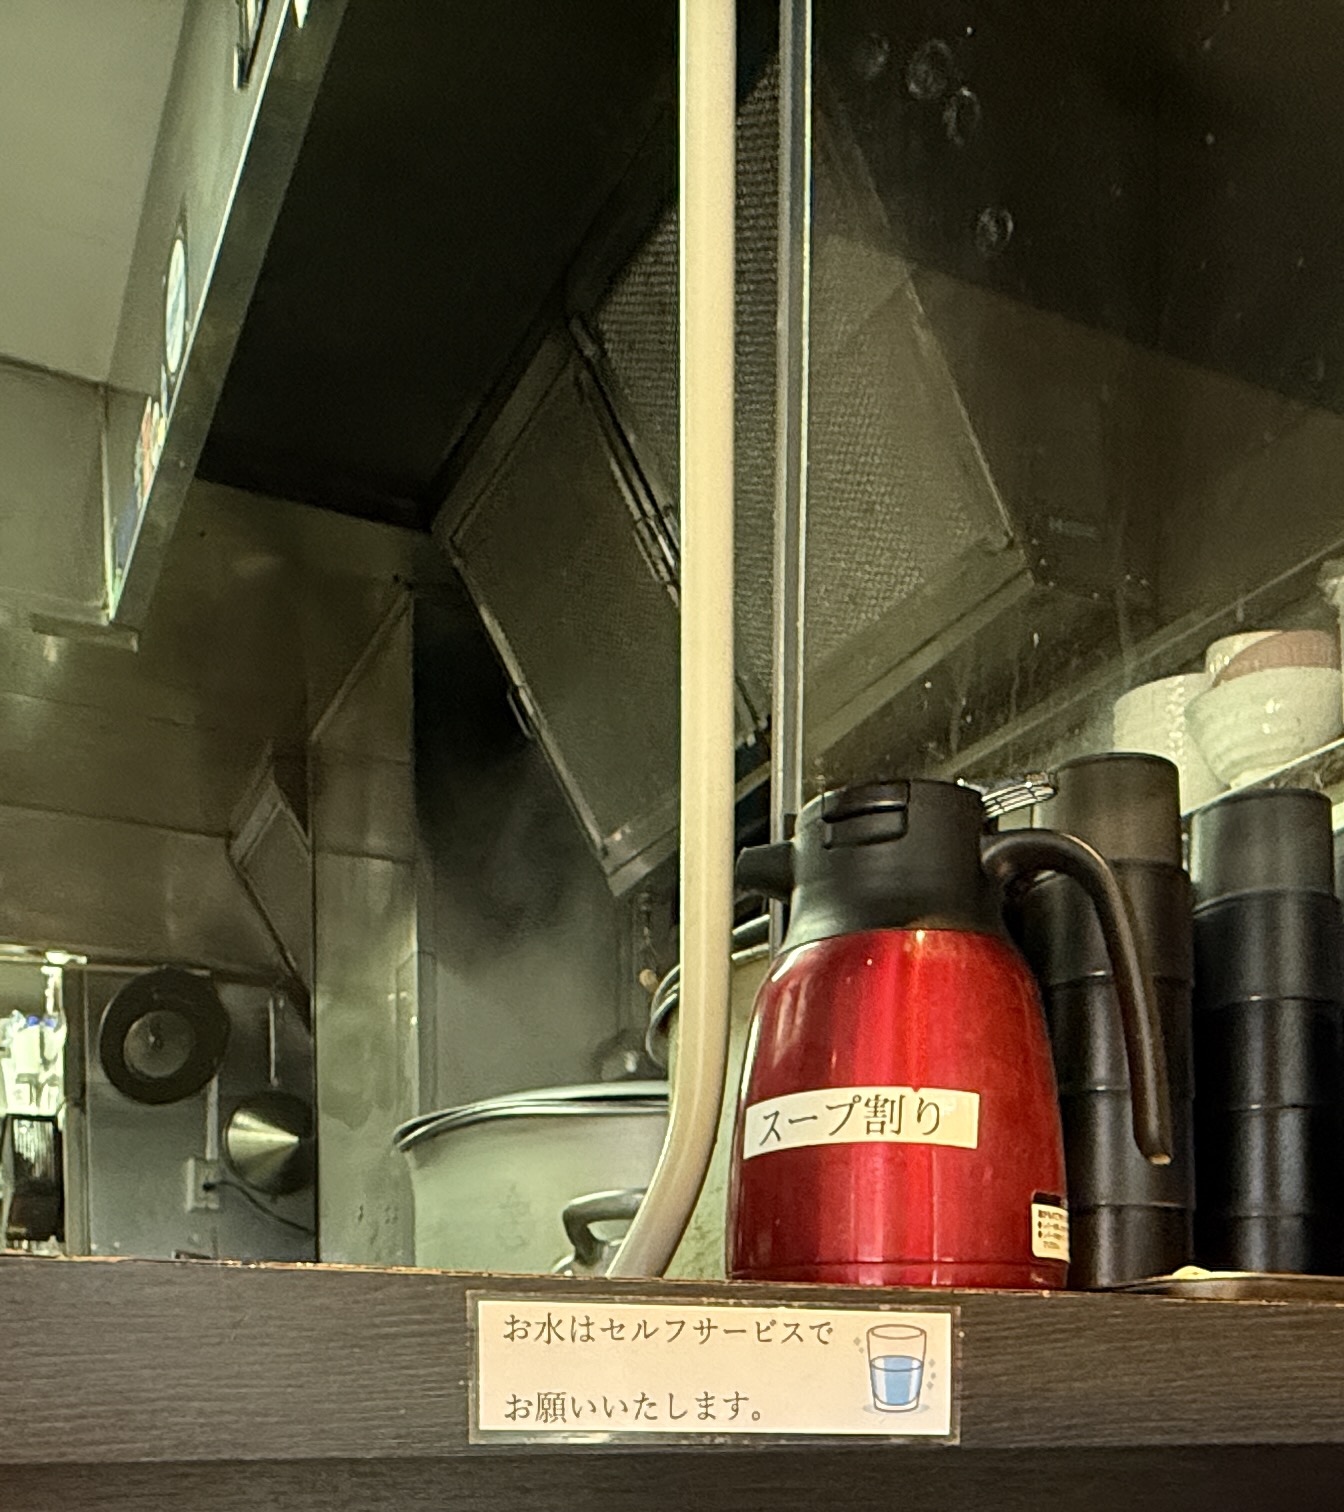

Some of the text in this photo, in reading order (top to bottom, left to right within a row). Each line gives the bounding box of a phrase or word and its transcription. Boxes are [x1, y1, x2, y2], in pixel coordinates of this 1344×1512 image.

[759, 1095, 943, 1146] スープ割り
[503, 1313, 834, 1346] お水はセルフサービスで
[505, 1391, 764, 1424] お願いいたします。
